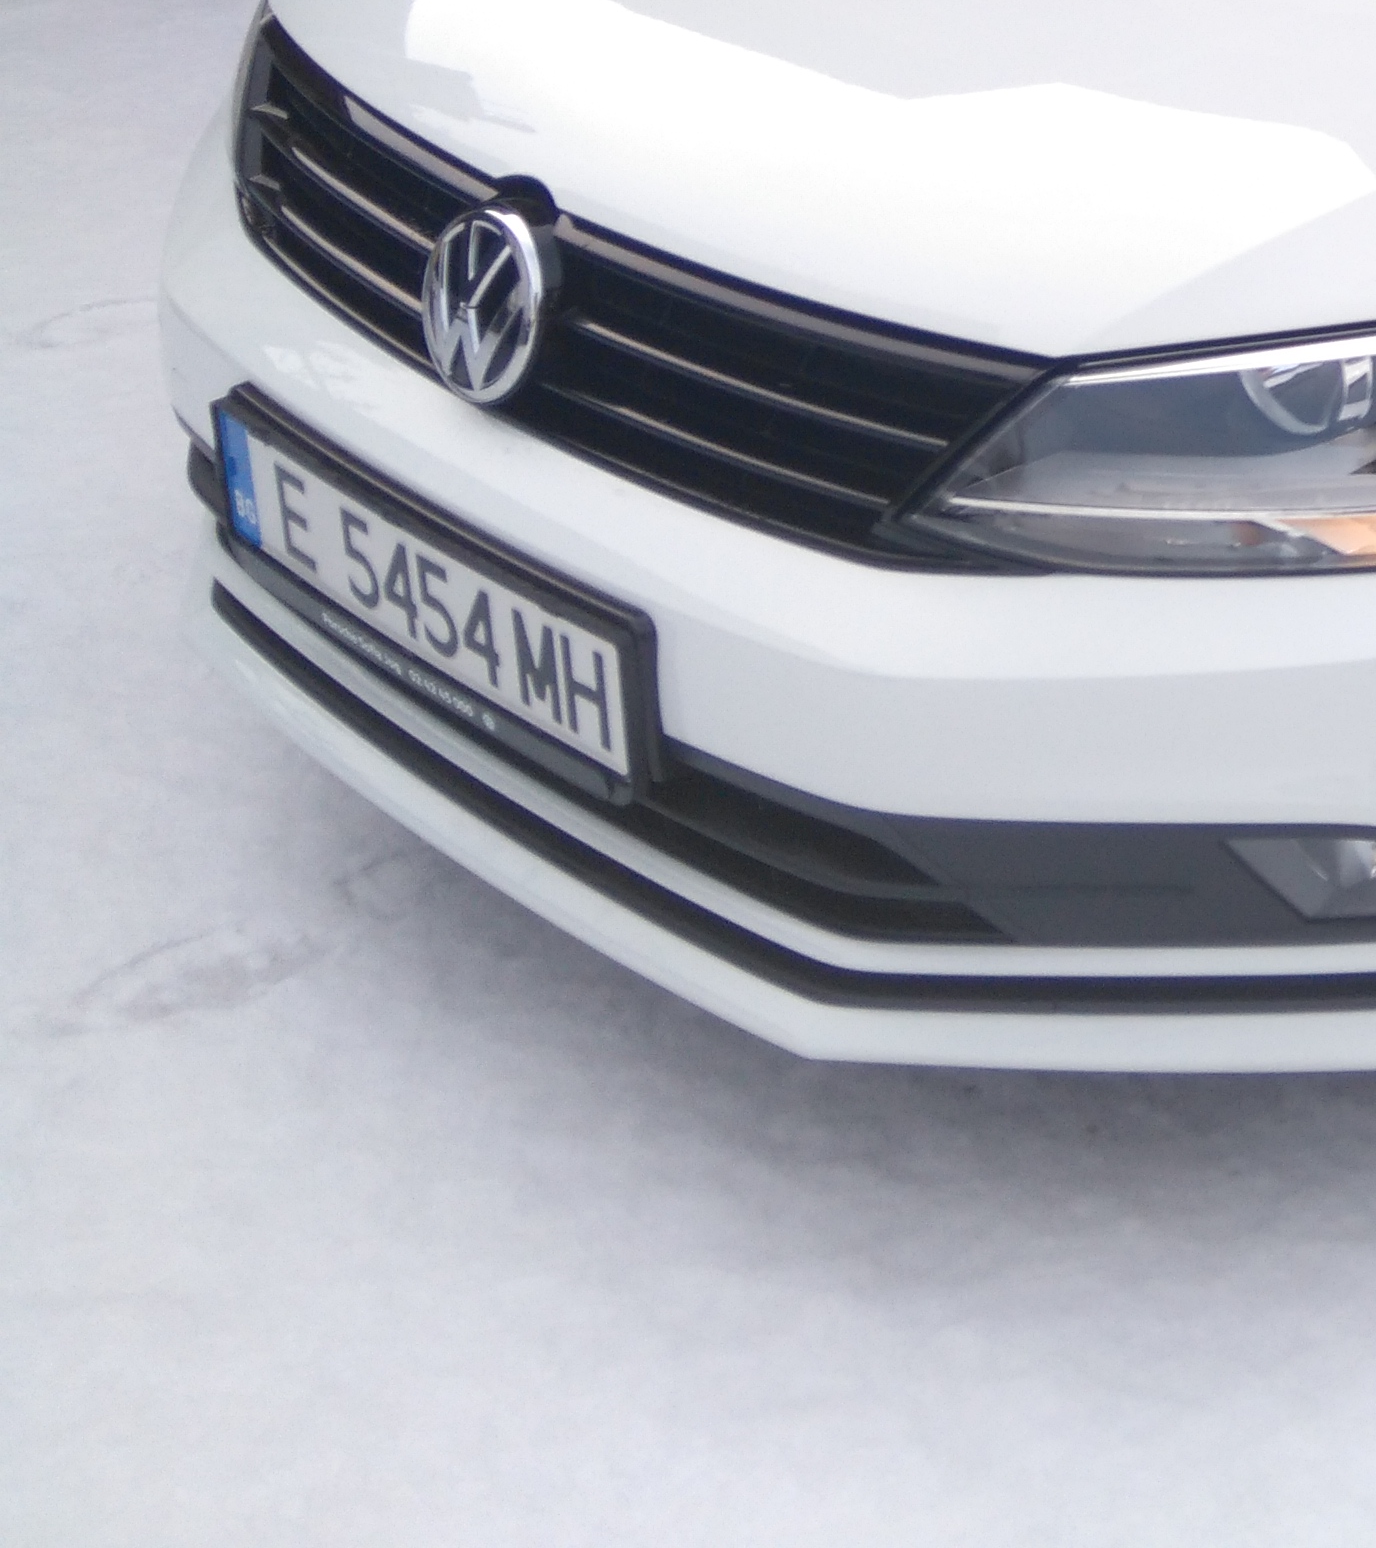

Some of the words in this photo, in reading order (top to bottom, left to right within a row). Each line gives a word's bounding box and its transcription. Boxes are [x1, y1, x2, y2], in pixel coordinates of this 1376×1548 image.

[273, 458, 316, 573] E
[339, 505, 500, 689] 5454
[512, 607, 613, 752] MH
